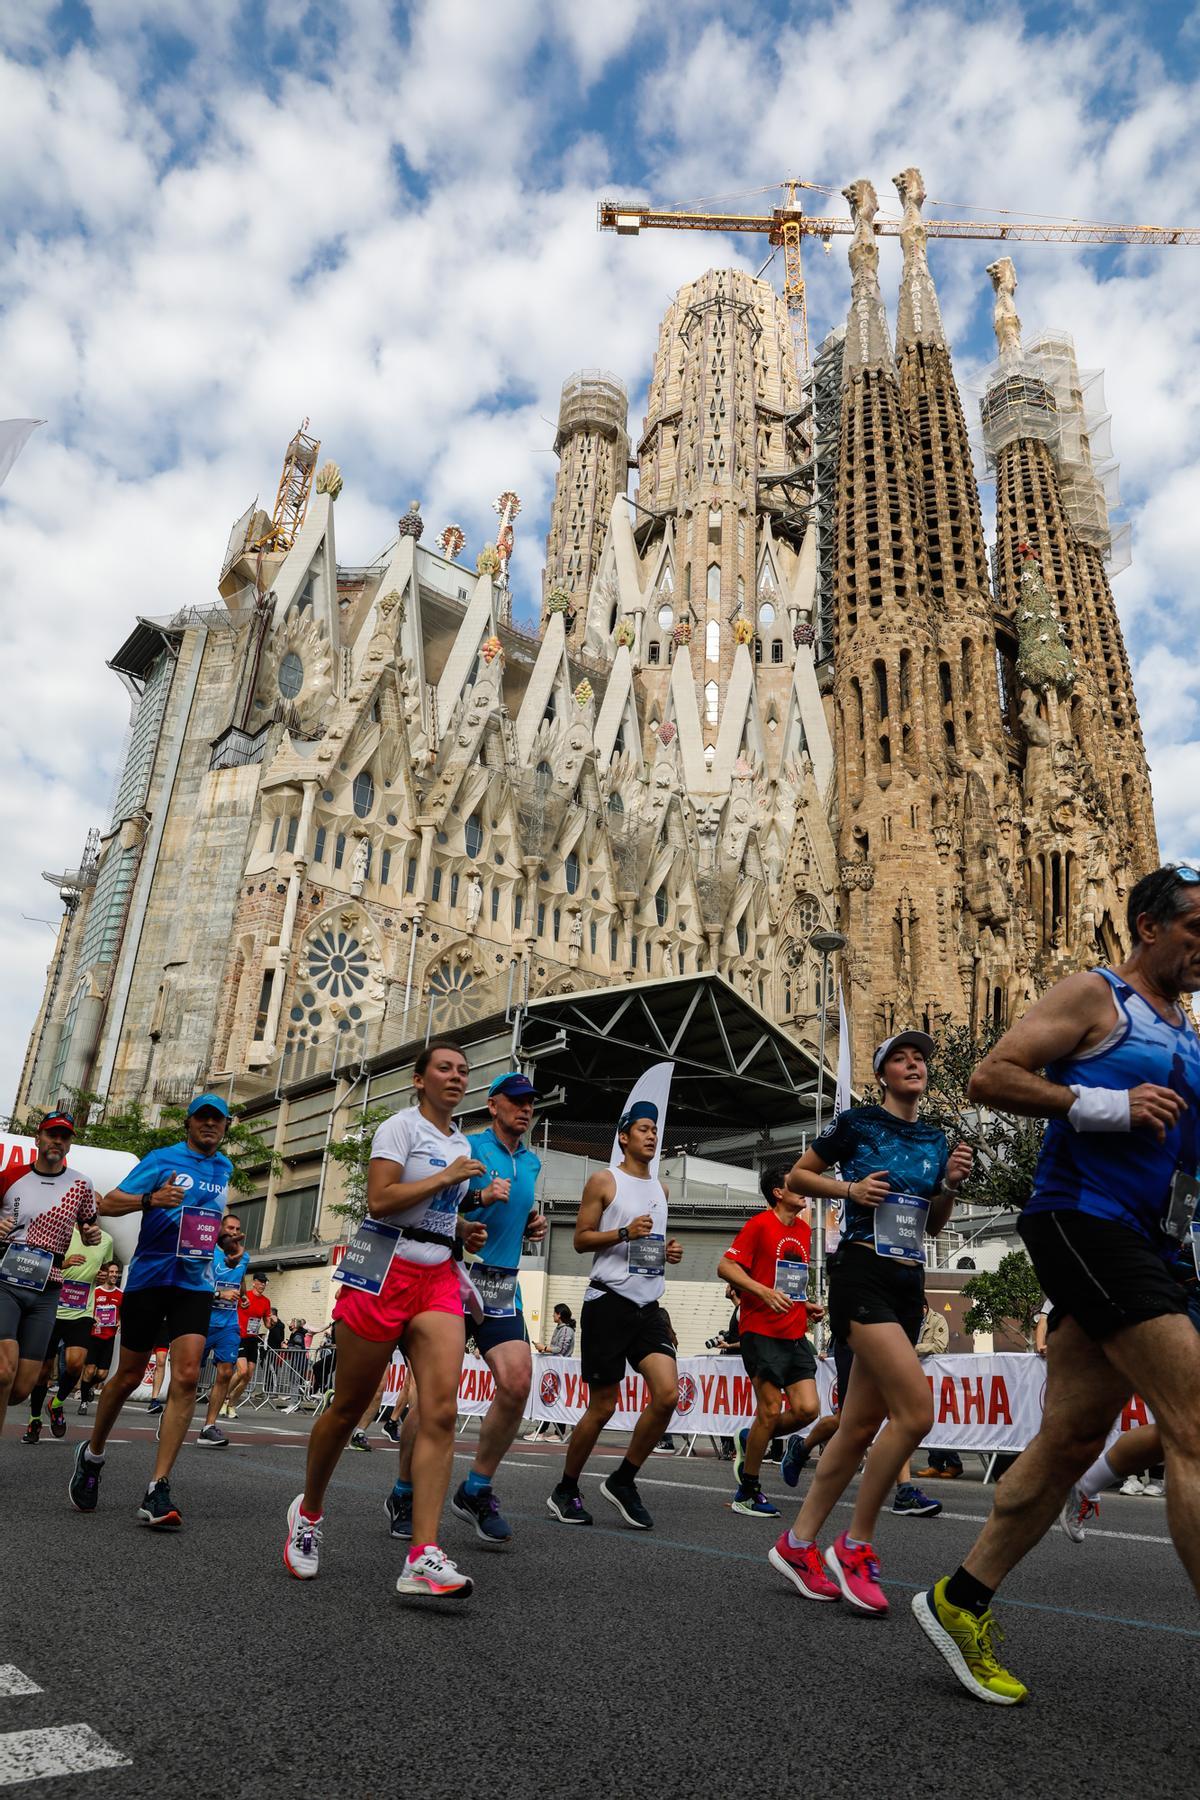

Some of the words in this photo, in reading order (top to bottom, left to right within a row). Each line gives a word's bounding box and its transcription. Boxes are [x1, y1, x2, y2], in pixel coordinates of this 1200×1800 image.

[197, 1224, 215, 1232] JOSEP
[16, 1256, 39, 1267] STEFAN
[346, 1252, 364, 1264] 6413
[459, 1368, 497, 1402] YAM
[564, 1373, 652, 1412] YAAHA
[700, 1375, 792, 1416] YAM
